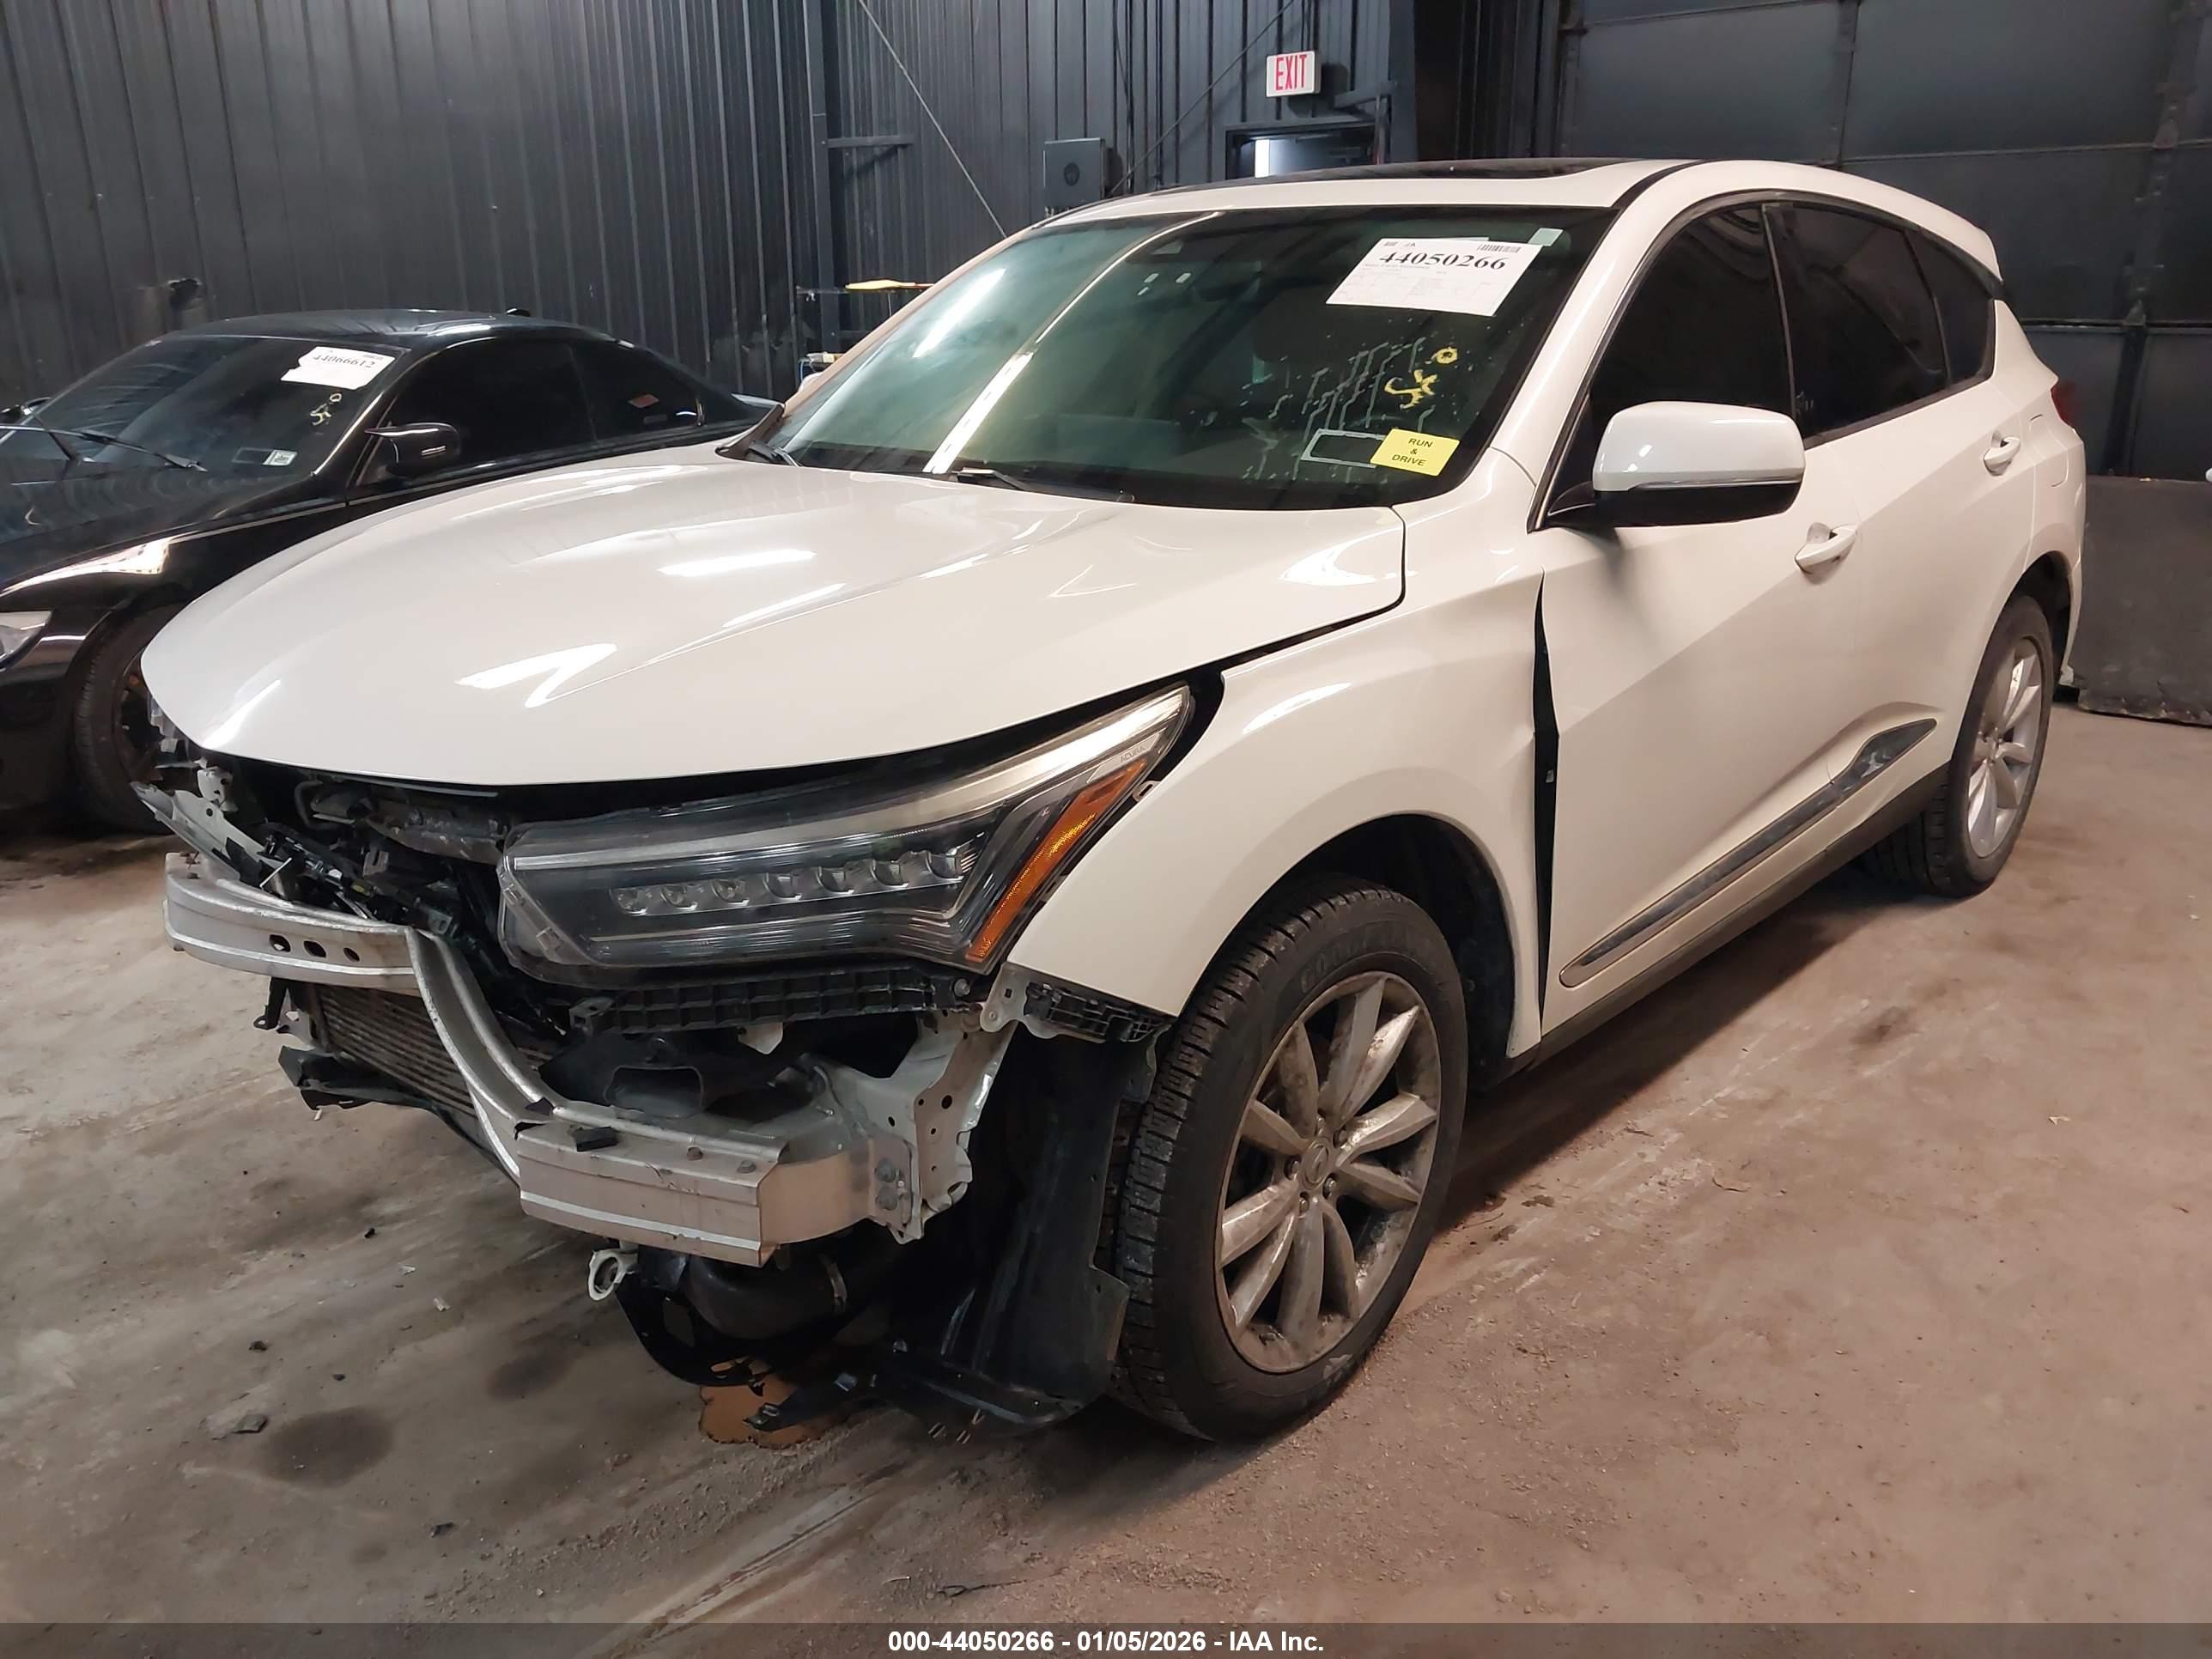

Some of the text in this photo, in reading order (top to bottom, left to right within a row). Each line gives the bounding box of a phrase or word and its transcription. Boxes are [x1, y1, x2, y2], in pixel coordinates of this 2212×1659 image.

[1276, 55, 1307, 90] EXIT
[1378, 251, 1510, 270] 44050266
[1408, 438, 1433, 447] RUN
[1391, 454, 1427, 466] DRIVE
